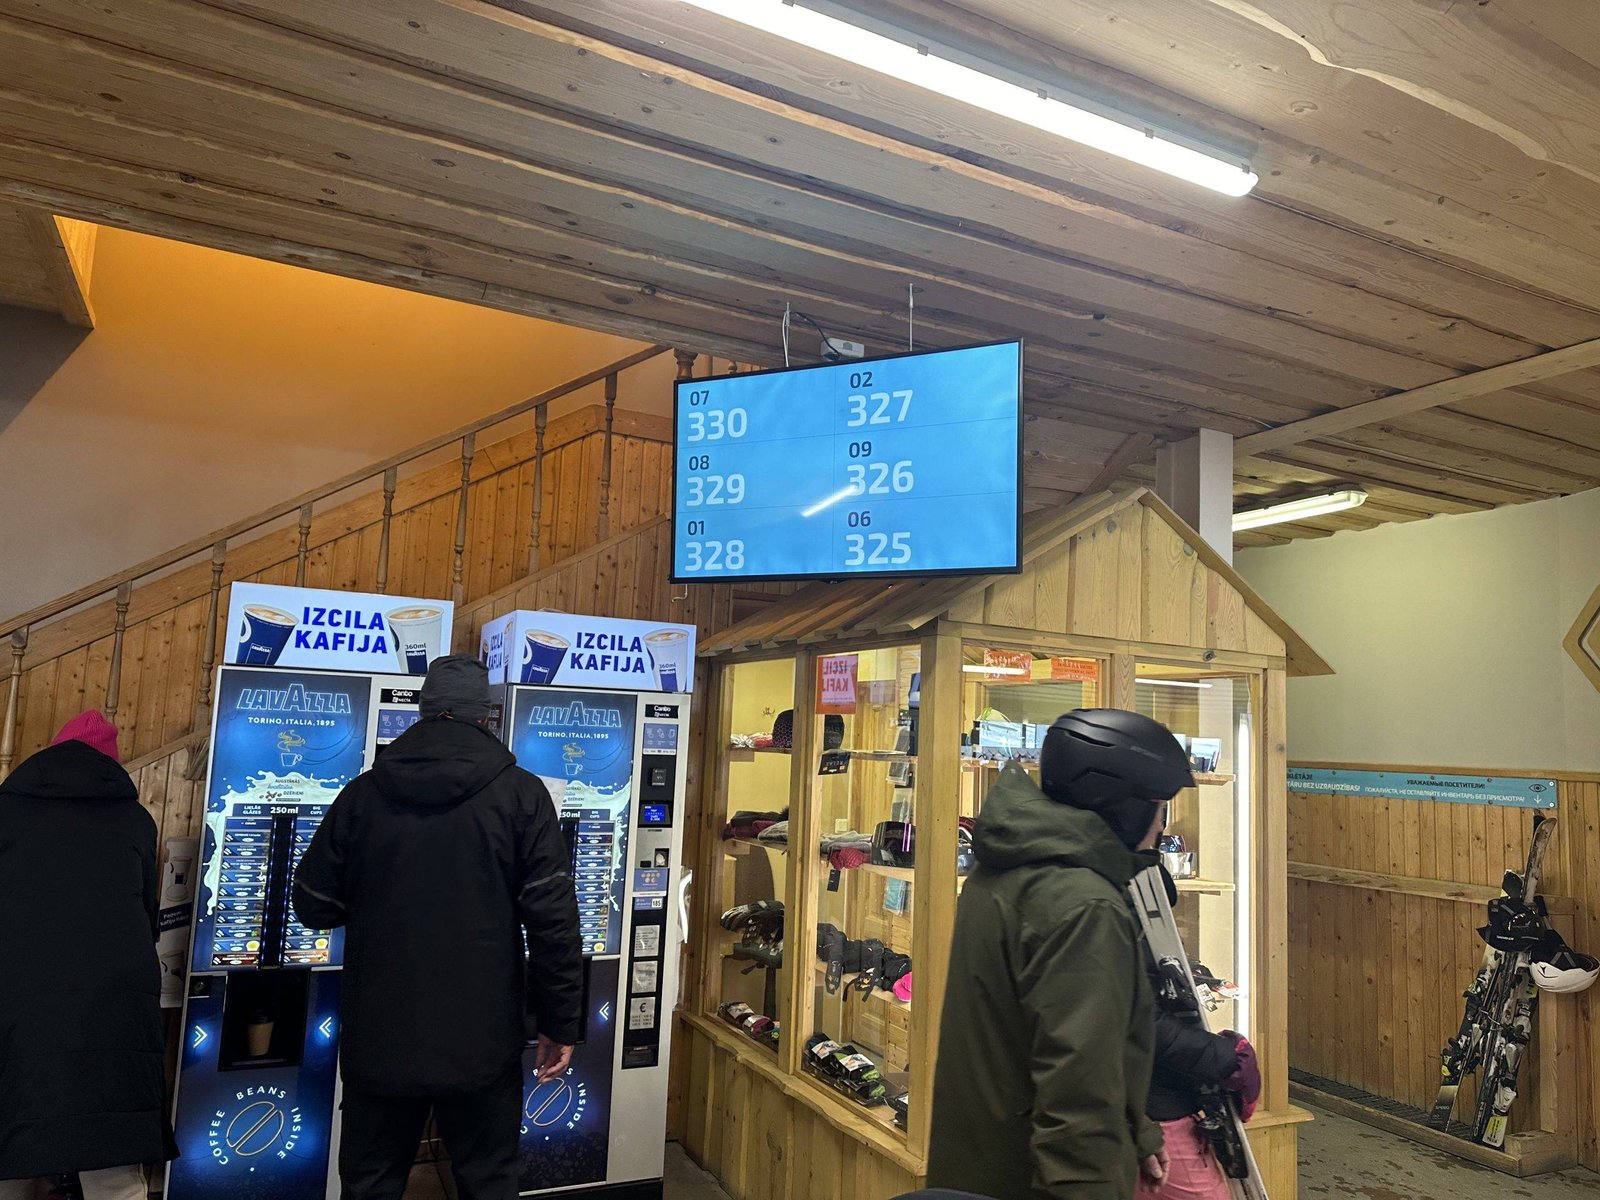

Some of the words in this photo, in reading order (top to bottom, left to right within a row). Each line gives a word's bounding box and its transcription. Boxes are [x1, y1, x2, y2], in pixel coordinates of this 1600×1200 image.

[850, 372, 873, 389] 02
[690, 391, 710, 406] 07
[847, 390, 914, 427] 327
[687, 407, 748, 442] 330
[849, 441, 872, 458] 09
[688, 455, 710, 470] 08
[686, 473, 745, 506] 329
[847, 460, 914, 496] 326
[687, 521, 705, 536] 01
[848, 511, 871, 527] 06
[684, 540, 745, 572] 328
[845, 532, 911, 566] 325
[302, 606, 385, 630] IZCILA
[294, 630, 388, 654] KAFIJA
[576, 631, 643, 653] IZCILA
[570, 652, 646, 674] KAFIJA
[236, 683, 351, 714] LAVAZZA
[392, 689, 413, 697] Canto
[316, 719, 335, 727] 1895
[529, 701, 622, 728] LAVAZZA
[1407, 779, 1443, 787] УВАЖАЕМЫЕ
[270, 806, 287, 814] 250
[287, 806, 299, 814] ml
[236, 1086, 286, 1100] BEANS
[567, 1083, 586, 1129] INSIDE
[209, 1110, 228, 1164] COFFEE
[277, 1107, 301, 1159] INSIDE
